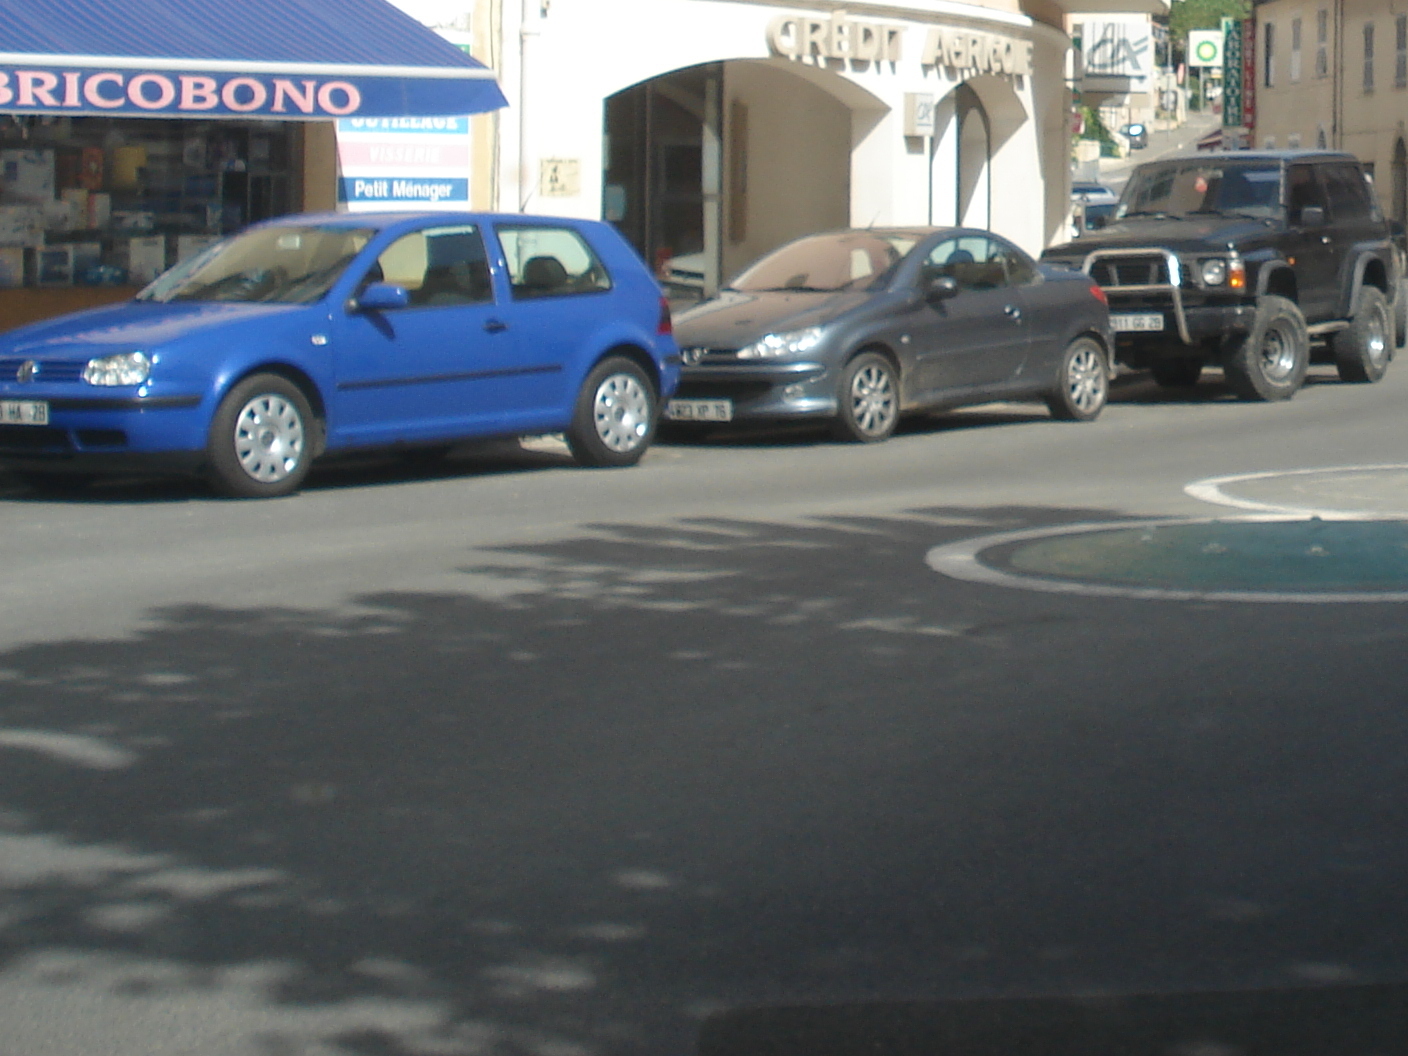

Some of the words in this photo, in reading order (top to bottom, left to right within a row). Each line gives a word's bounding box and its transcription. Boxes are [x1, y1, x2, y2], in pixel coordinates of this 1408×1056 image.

[369, 146, 440, 163] VISSERIE
[355, 180, 388, 198] Petit
[393, 180, 453, 201] Ménager
